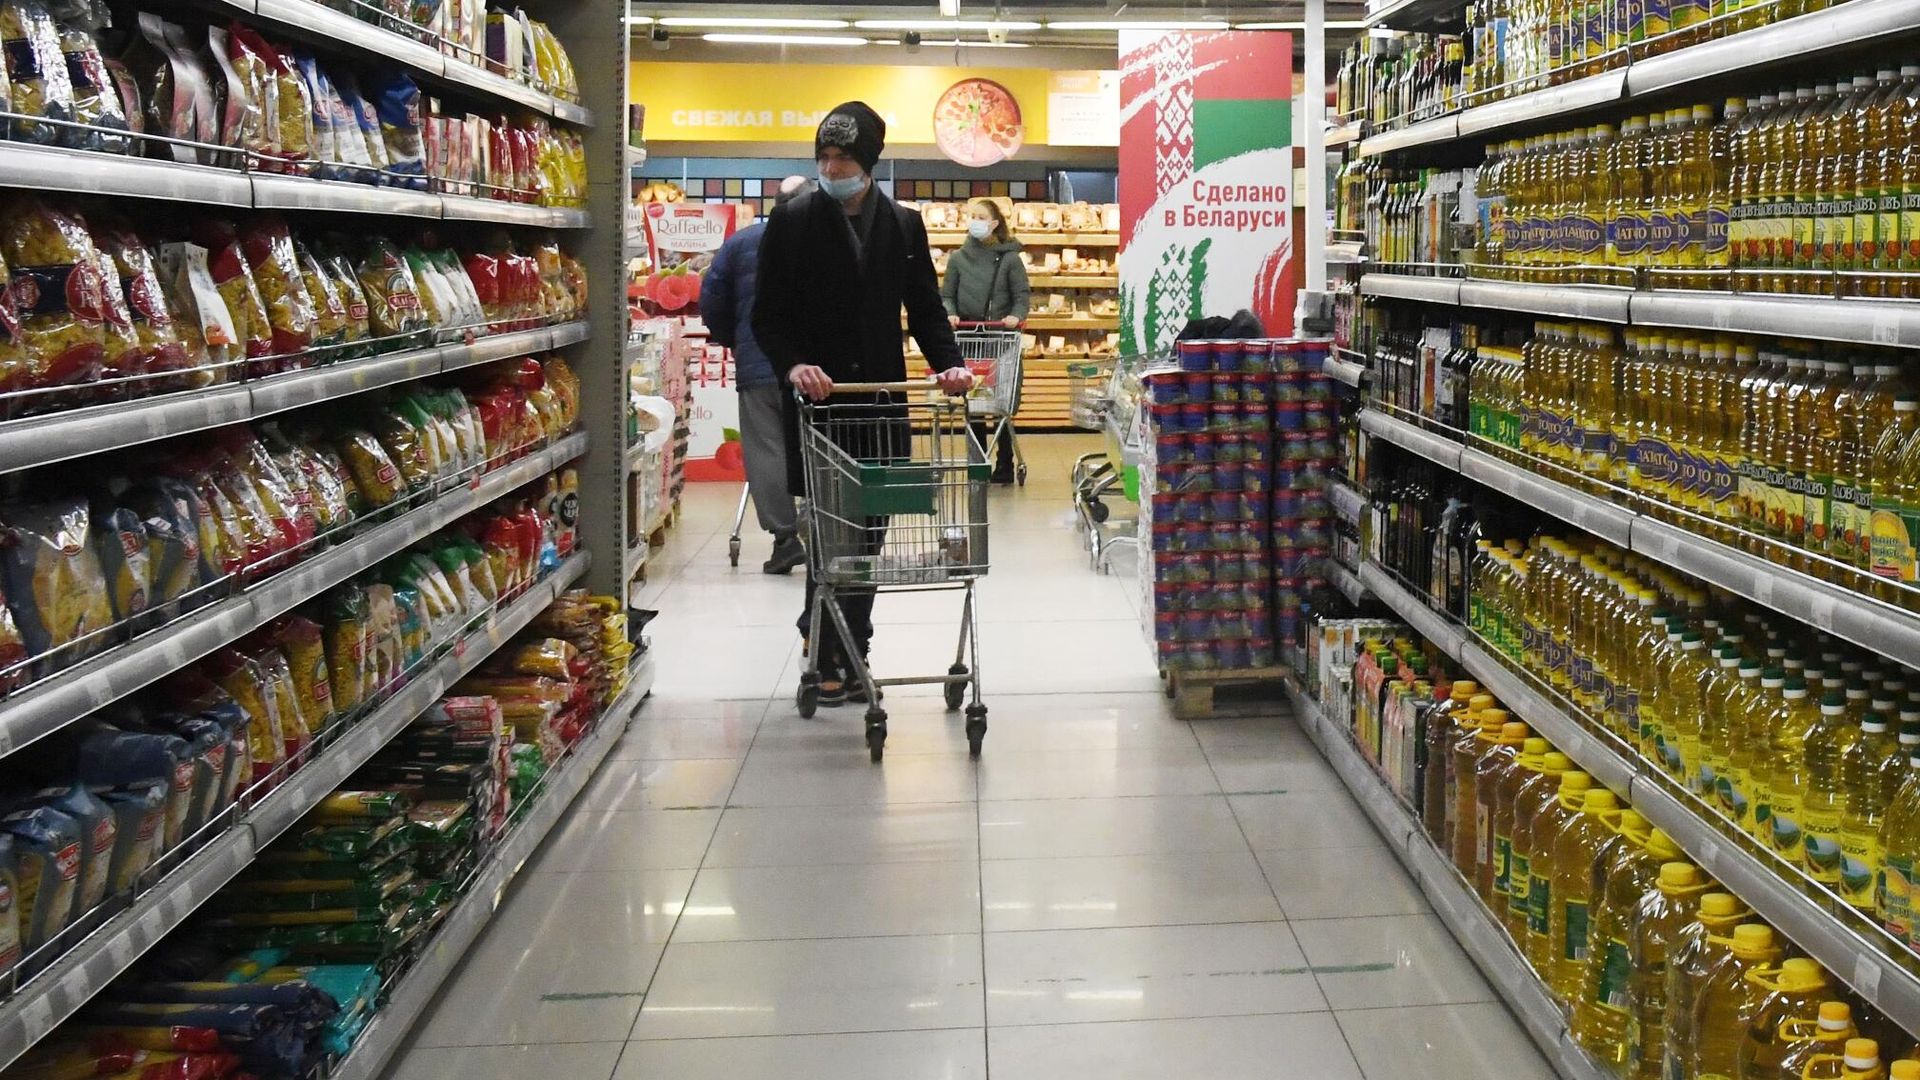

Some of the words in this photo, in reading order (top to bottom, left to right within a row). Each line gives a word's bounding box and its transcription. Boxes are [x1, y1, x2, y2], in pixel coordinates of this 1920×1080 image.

[671, 109, 773, 127] СВЕЖАЯ
[1193, 180, 1286, 206] Сделано
[657, 219, 723, 235] Raffaello
[1164, 210, 1176, 227] в
[1183, 205, 1286, 232] Беларуси
[671, 241, 707, 249] МАЛИНА
